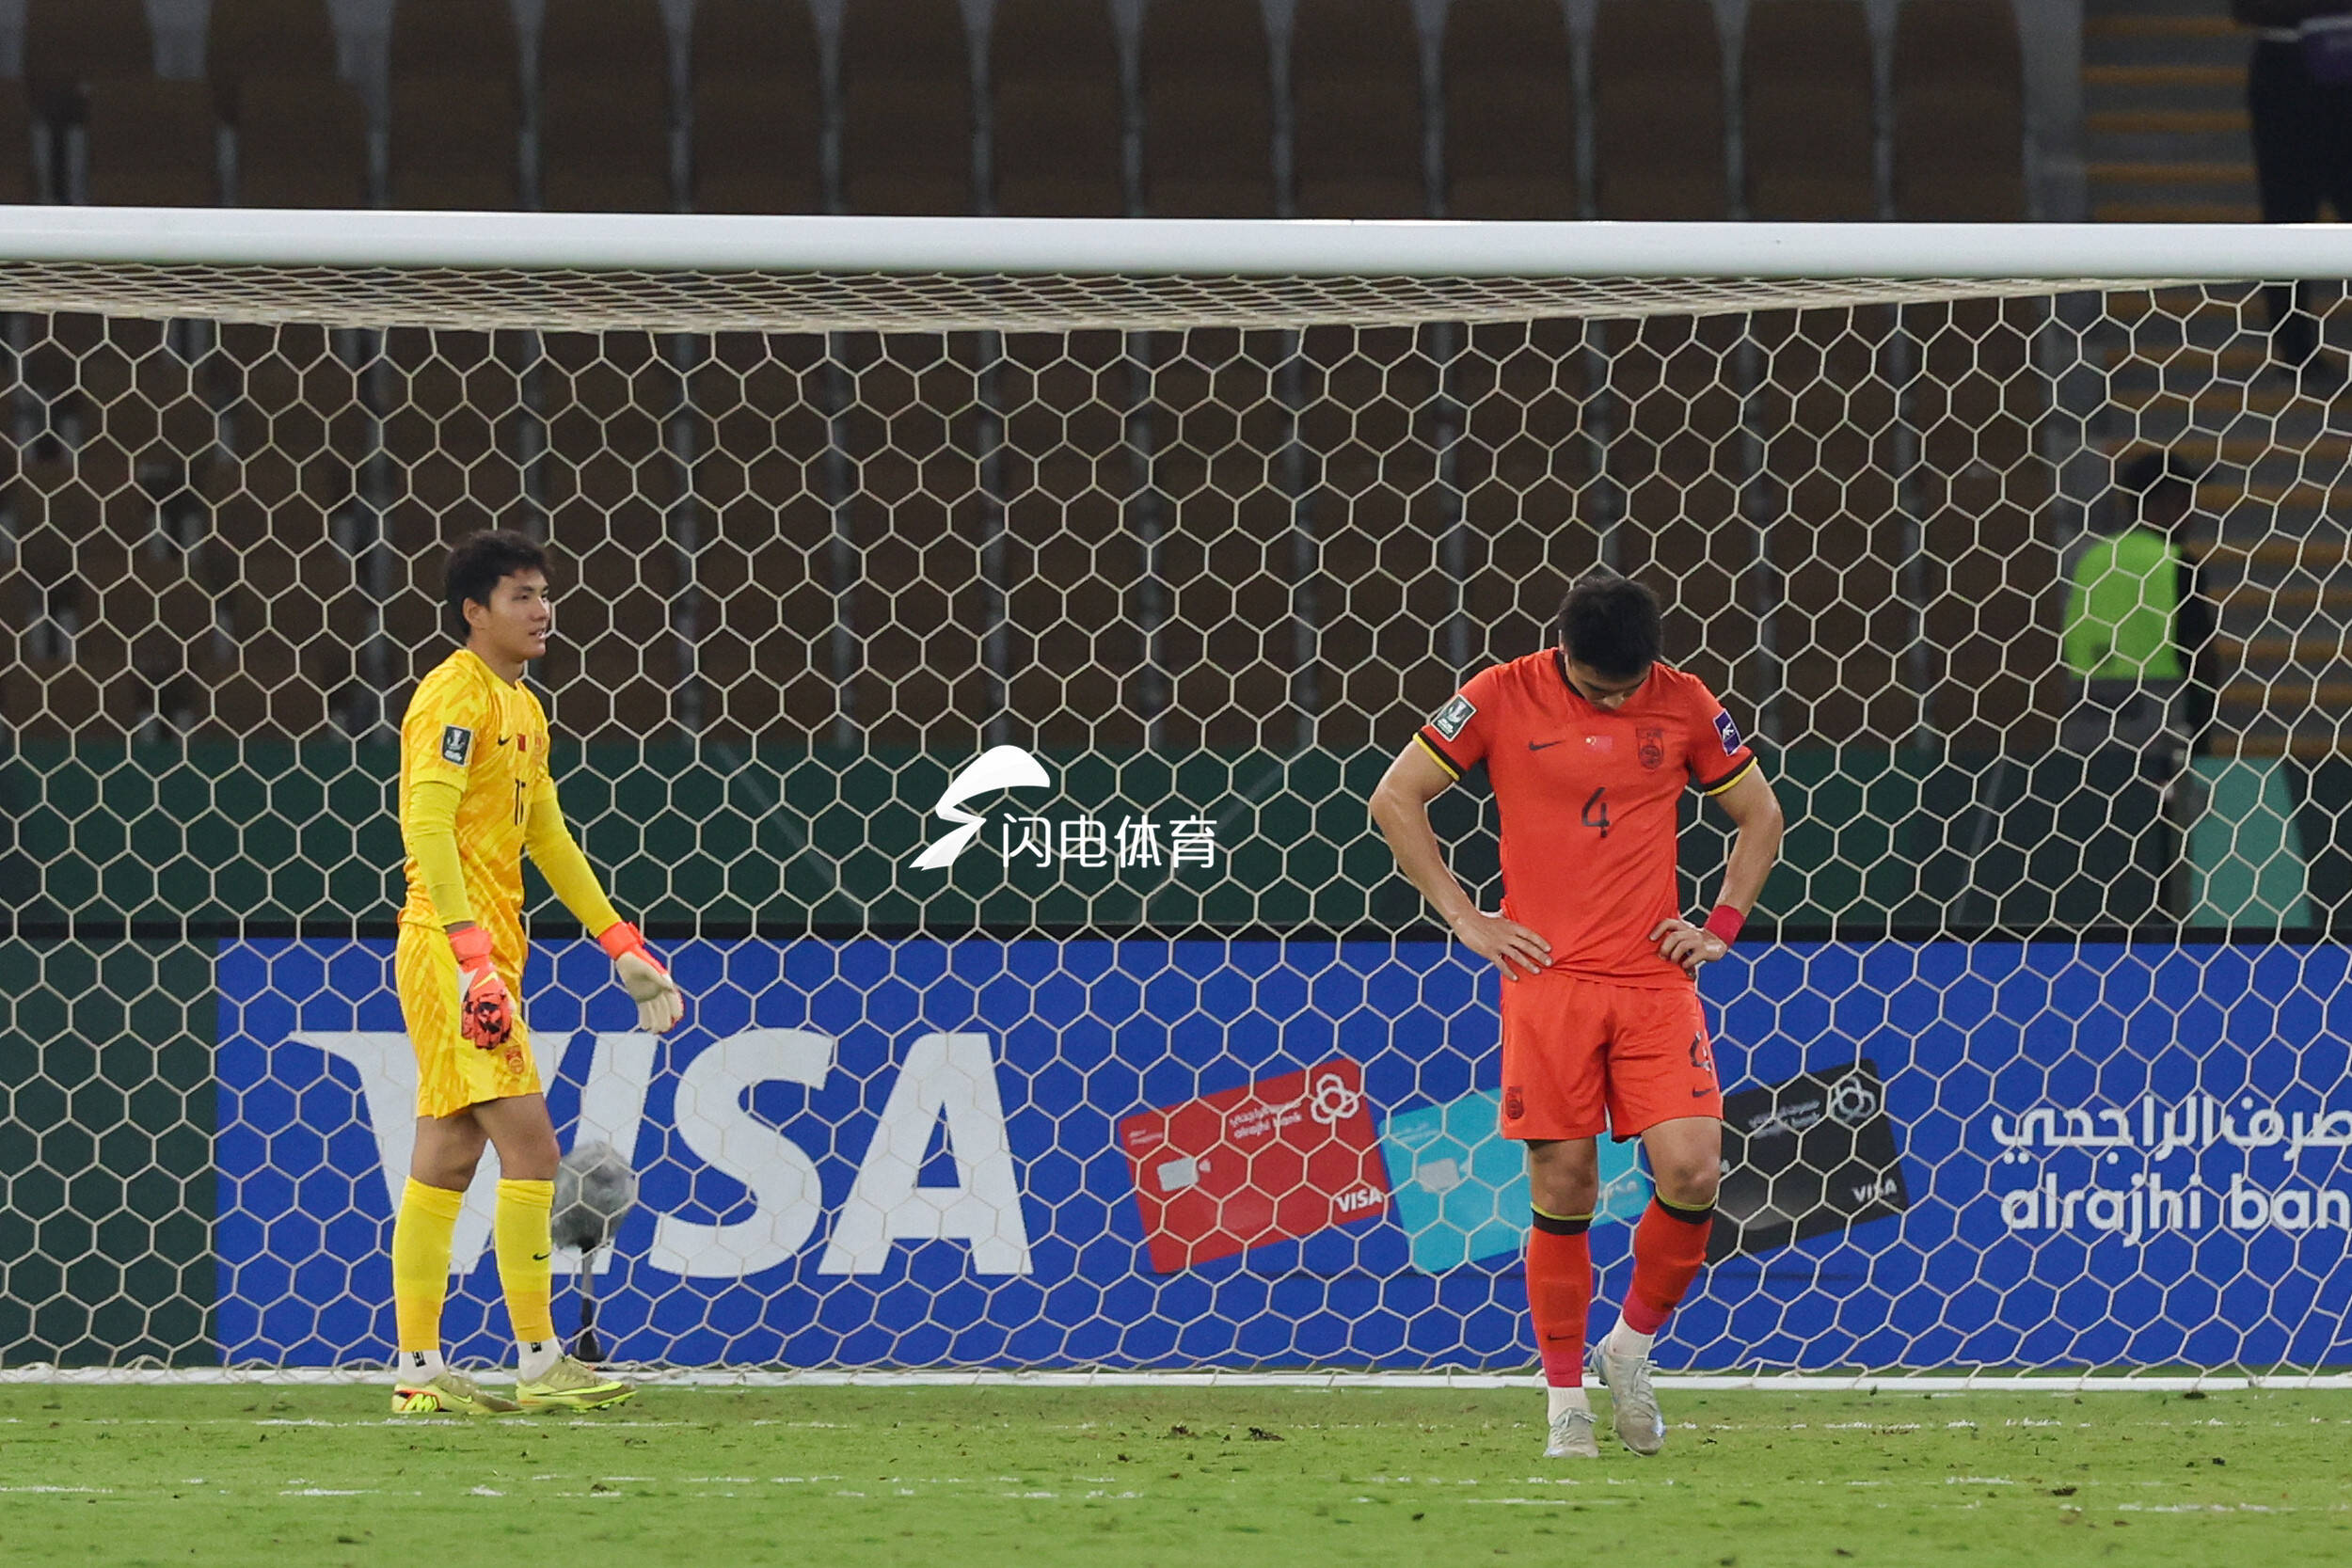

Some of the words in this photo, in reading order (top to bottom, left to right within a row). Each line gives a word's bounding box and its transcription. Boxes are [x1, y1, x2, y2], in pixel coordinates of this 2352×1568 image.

[1581, 786, 1610, 838] 4
[2223, 1096, 2352, 1162] صرف
[1335, 1185, 1383, 1212] VISA
[2000, 1172, 2202, 1248] alrajhi
[2231, 1173, 2351, 1230] ban
